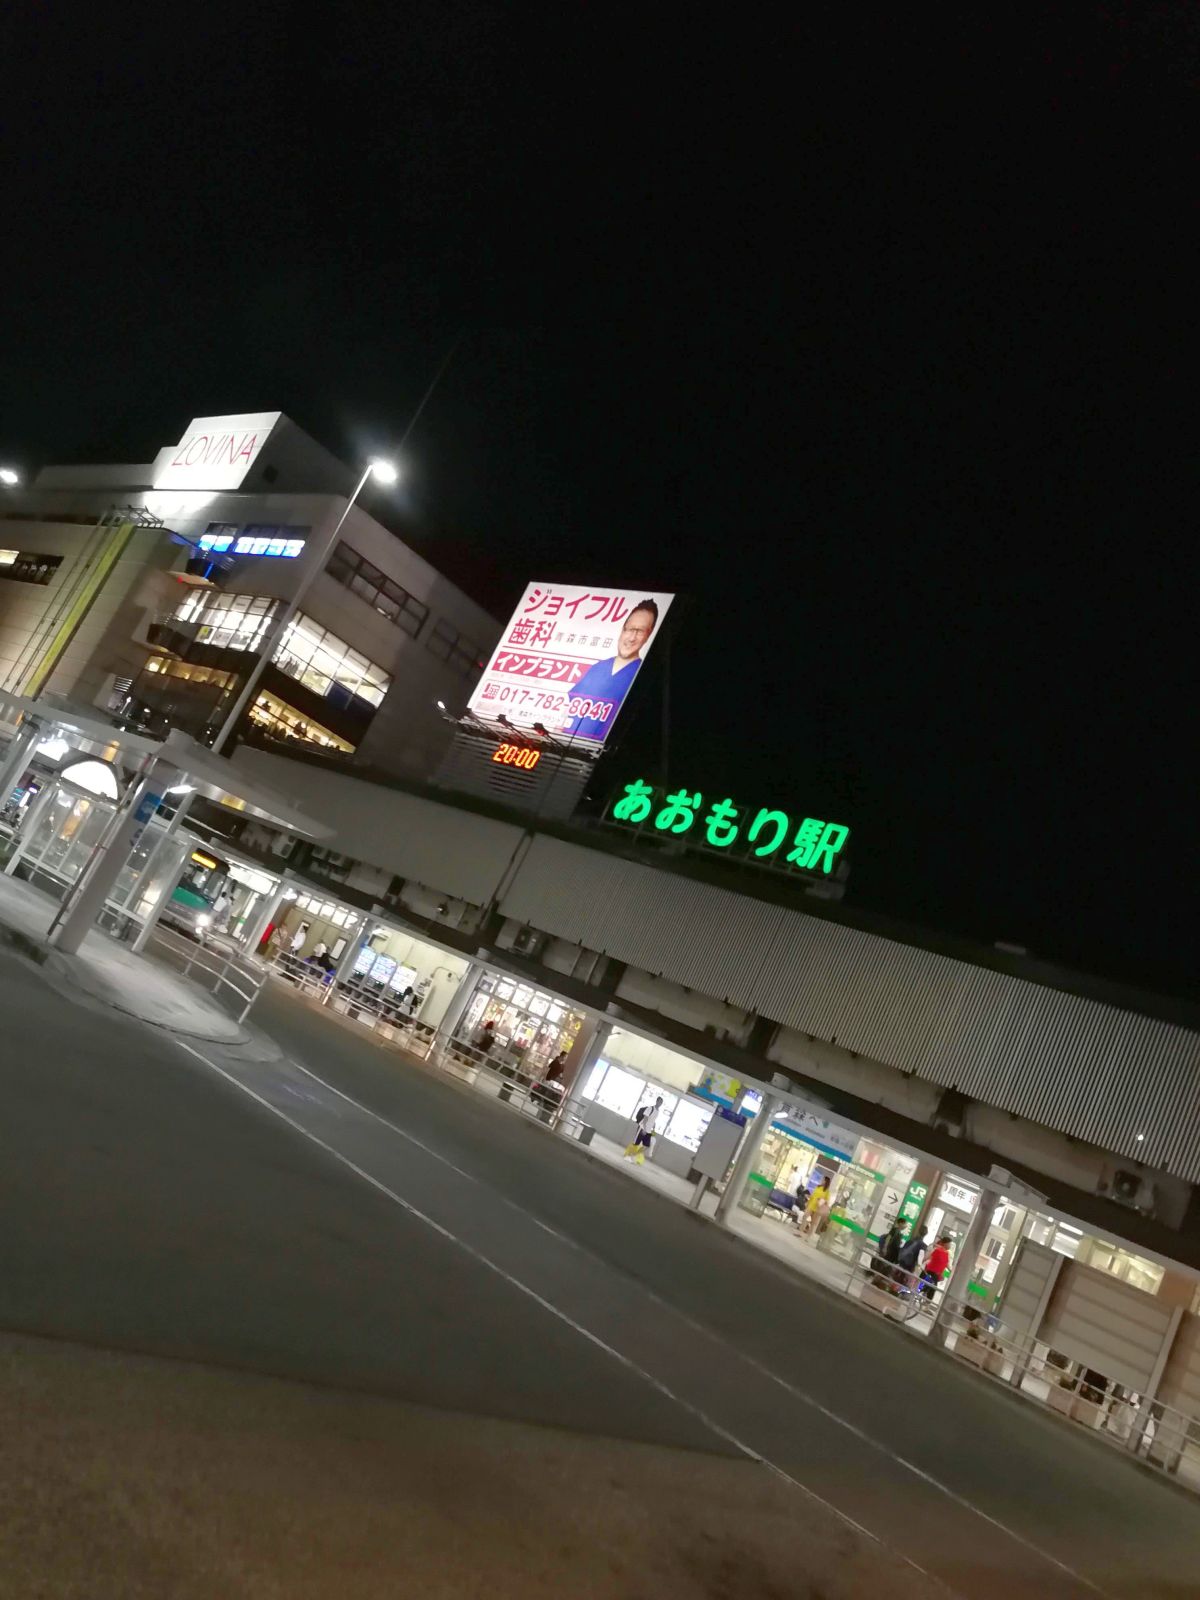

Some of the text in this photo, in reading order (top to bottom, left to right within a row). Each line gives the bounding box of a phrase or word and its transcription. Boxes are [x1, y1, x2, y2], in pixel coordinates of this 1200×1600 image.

[172, 434, 257, 467] LOVINA
[524, 589, 628, 622] ジョイフル
[511, 618, 556, 648] 歯科
[496, 654, 582, 682] インプラント
[499, 689, 613, 722] 017-782-8041
[492, 743, 541, 769] 20:00
[613, 778, 850, 874] あおもり駅
[909, 1186, 927, 1199] JR
